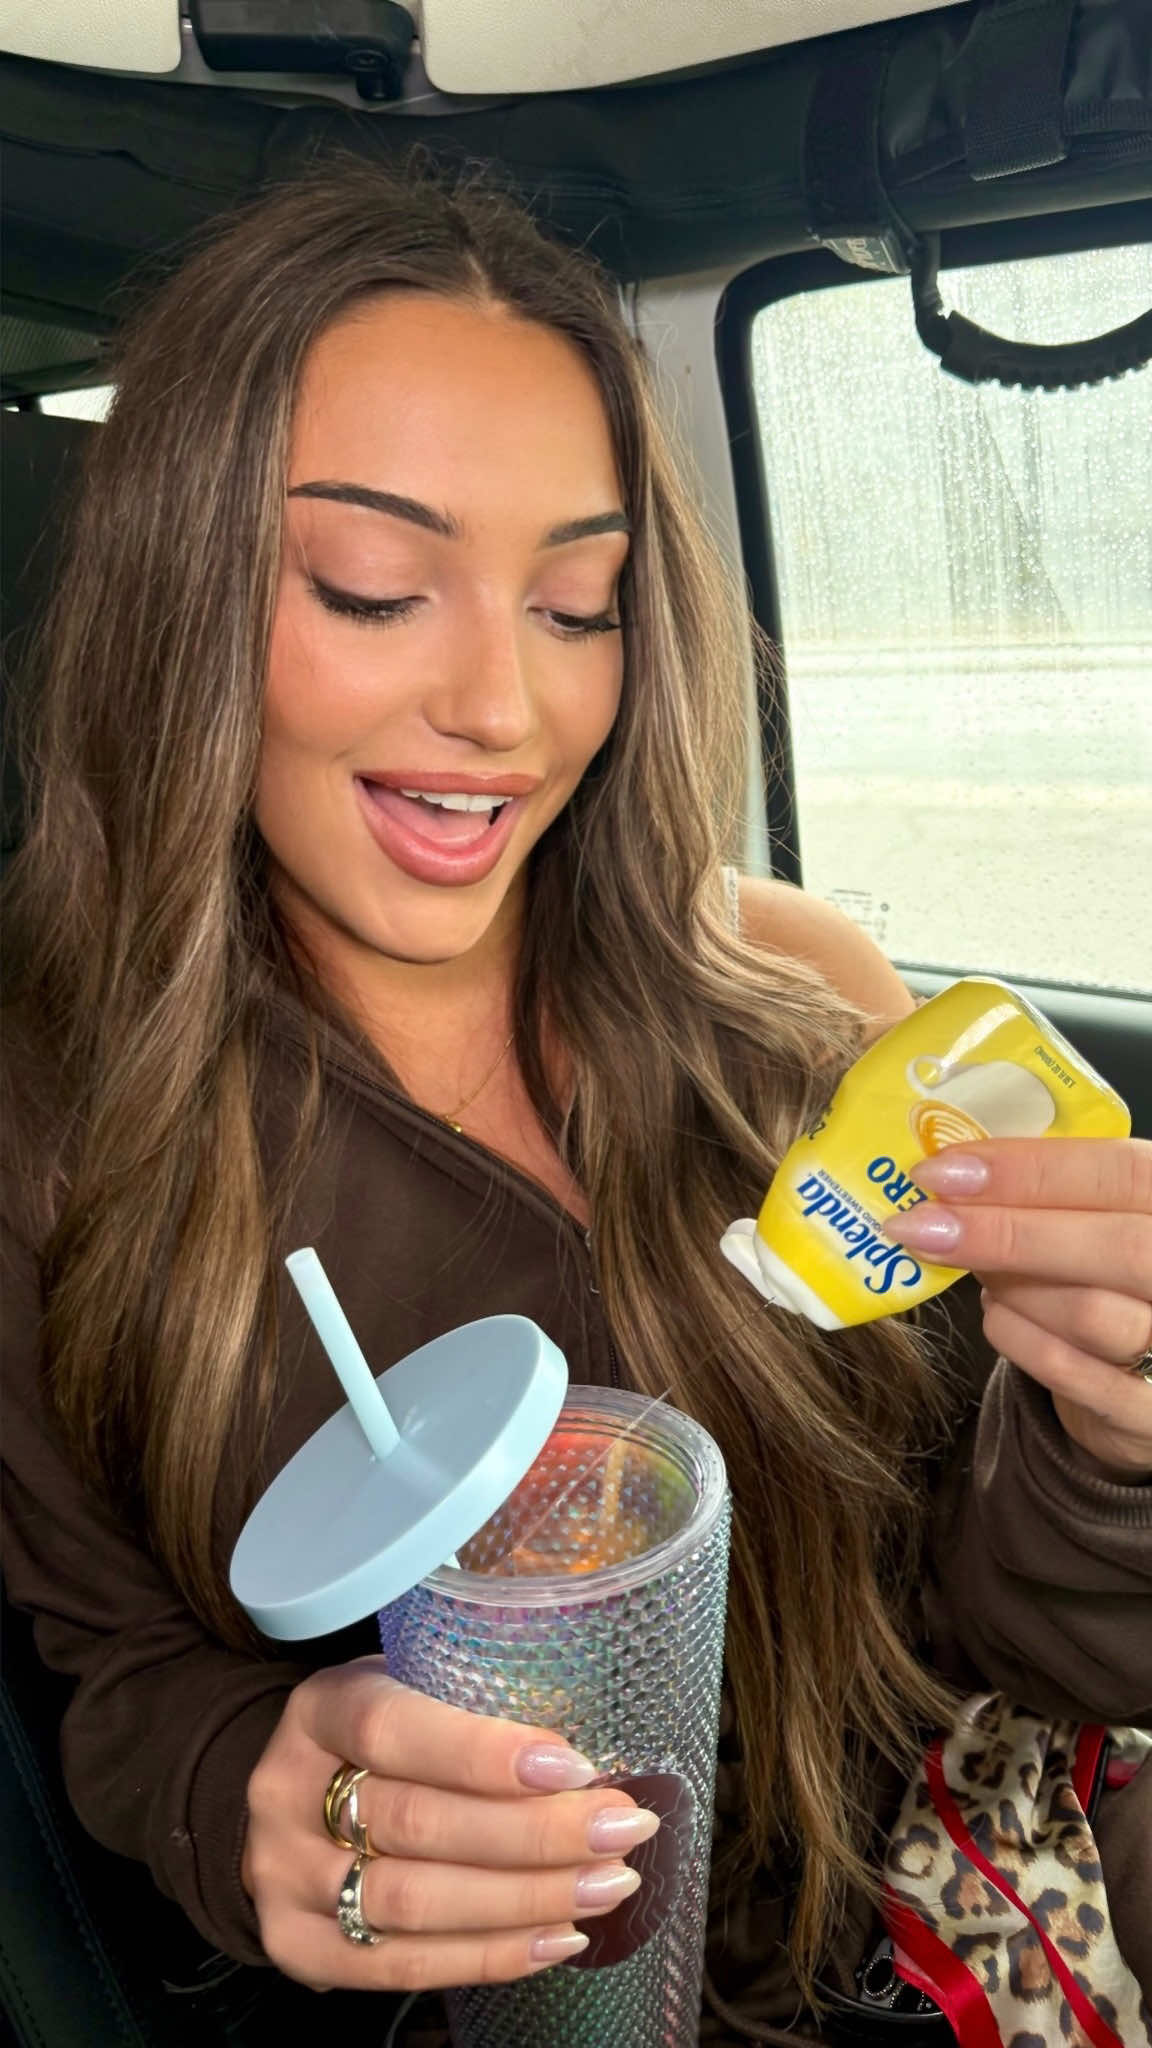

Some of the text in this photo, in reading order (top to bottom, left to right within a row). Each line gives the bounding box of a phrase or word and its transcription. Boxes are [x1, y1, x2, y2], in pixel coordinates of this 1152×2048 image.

[817, 1168, 863, 1213] SWEETENER
[867, 1157, 928, 1211] ERO
[796, 1176, 922, 1294] Splenda
